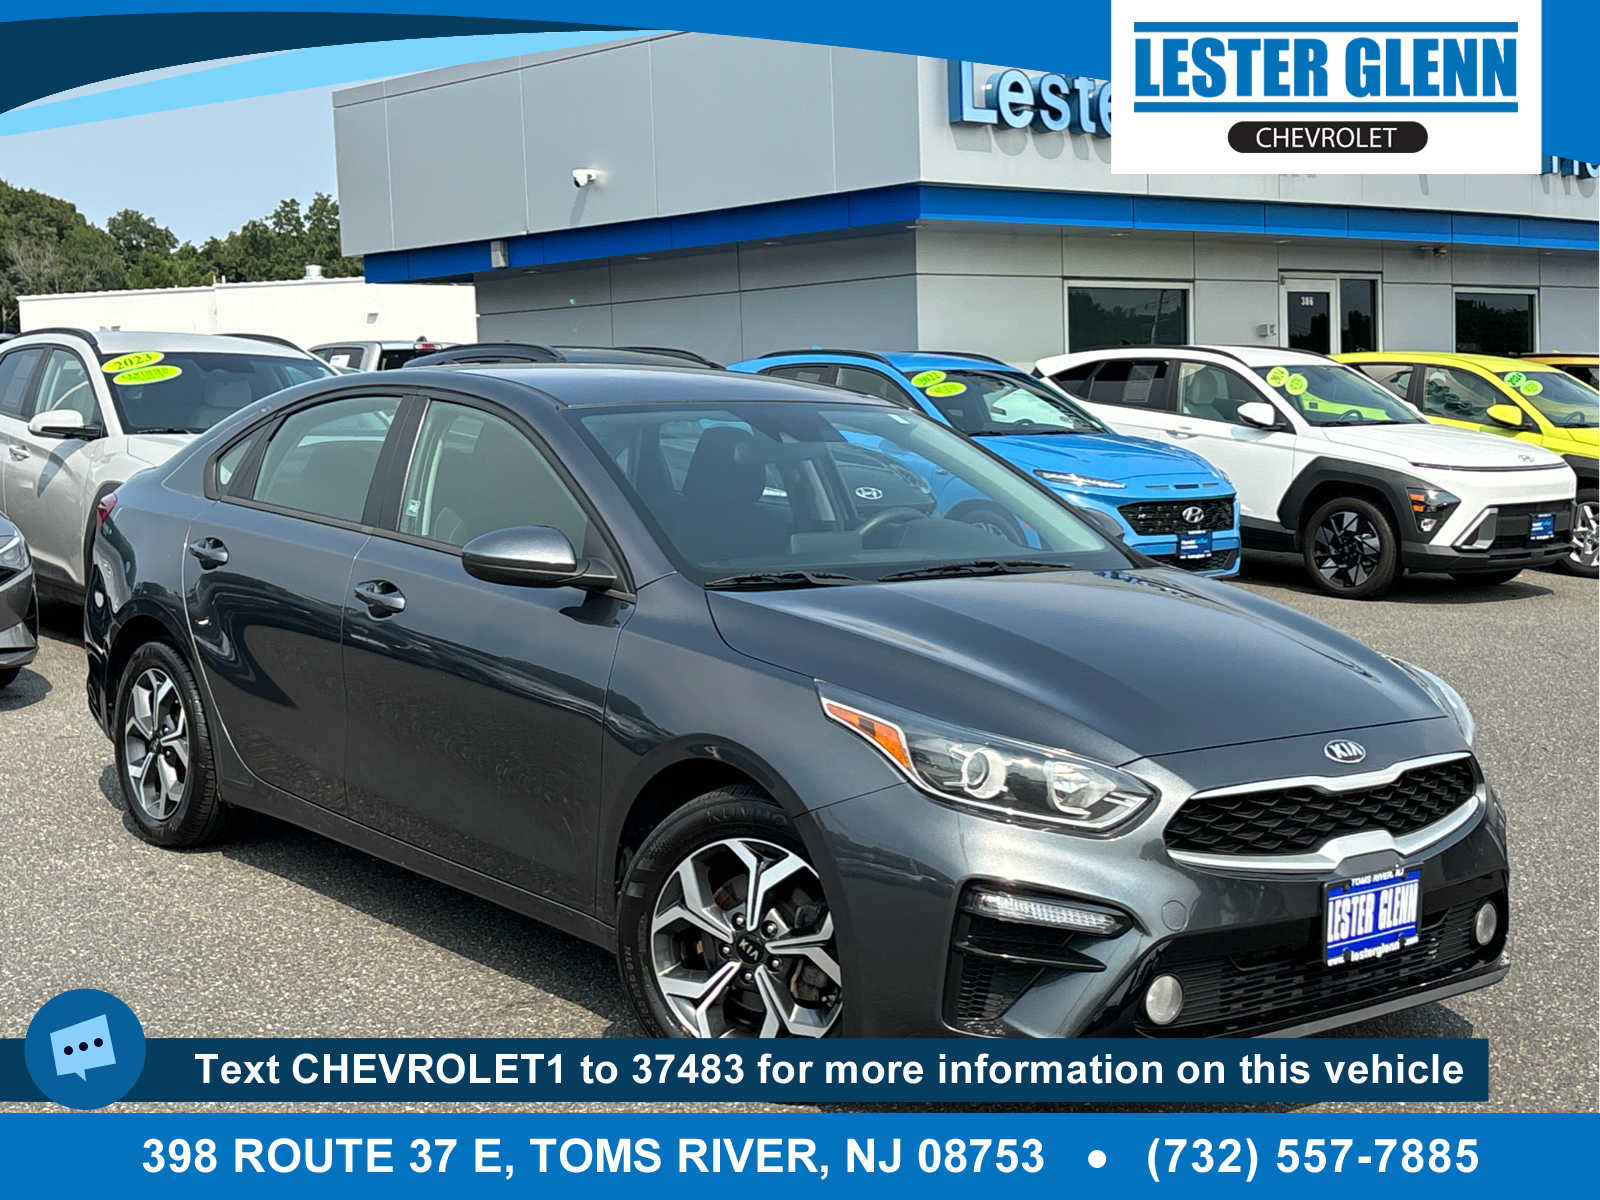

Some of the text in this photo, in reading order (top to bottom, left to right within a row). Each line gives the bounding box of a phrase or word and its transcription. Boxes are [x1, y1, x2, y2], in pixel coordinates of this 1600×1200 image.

[114, 353, 154, 368] 2023
[1327, 741, 1364, 759] KIA
[1351, 875, 1372, 887] TOMS
[1327, 882, 1419, 943] LESTER GLENN
[738, 938, 759, 961] KIA
